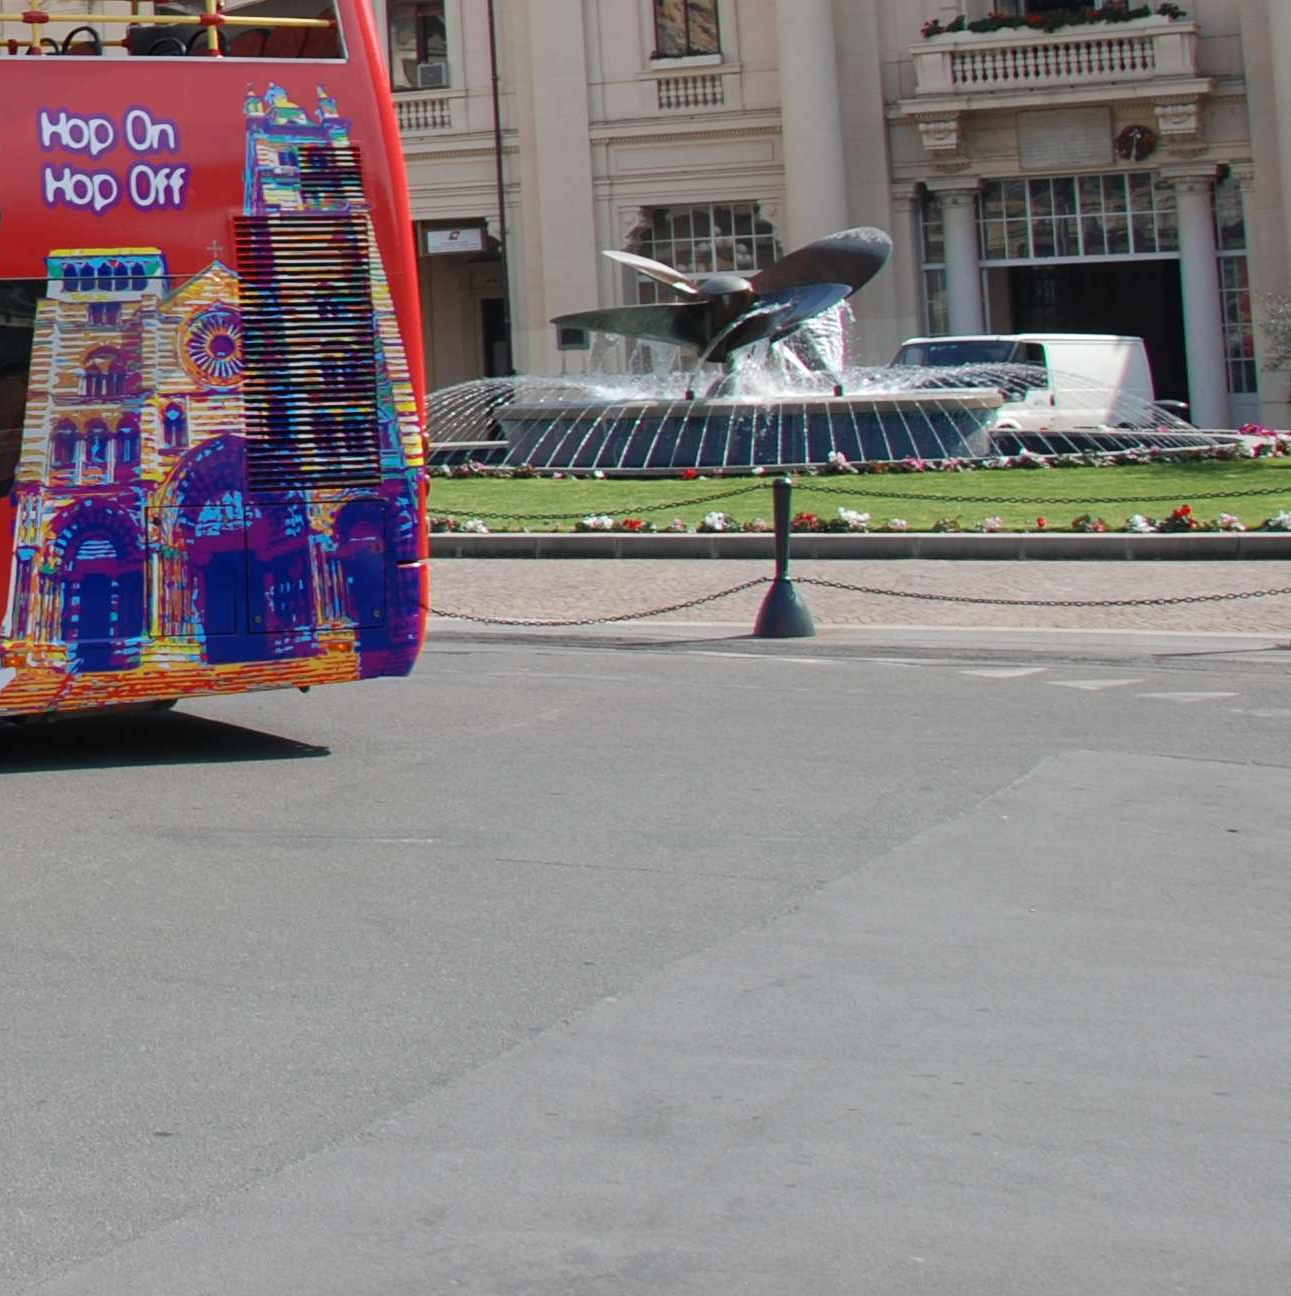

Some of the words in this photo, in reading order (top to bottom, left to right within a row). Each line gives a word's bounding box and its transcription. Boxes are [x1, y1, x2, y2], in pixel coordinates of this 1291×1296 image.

[40, 111, 114, 155] Hop
[125, 108, 176, 151] On
[44, 166, 118, 211] Hop
[130, 164, 186, 206] Off
